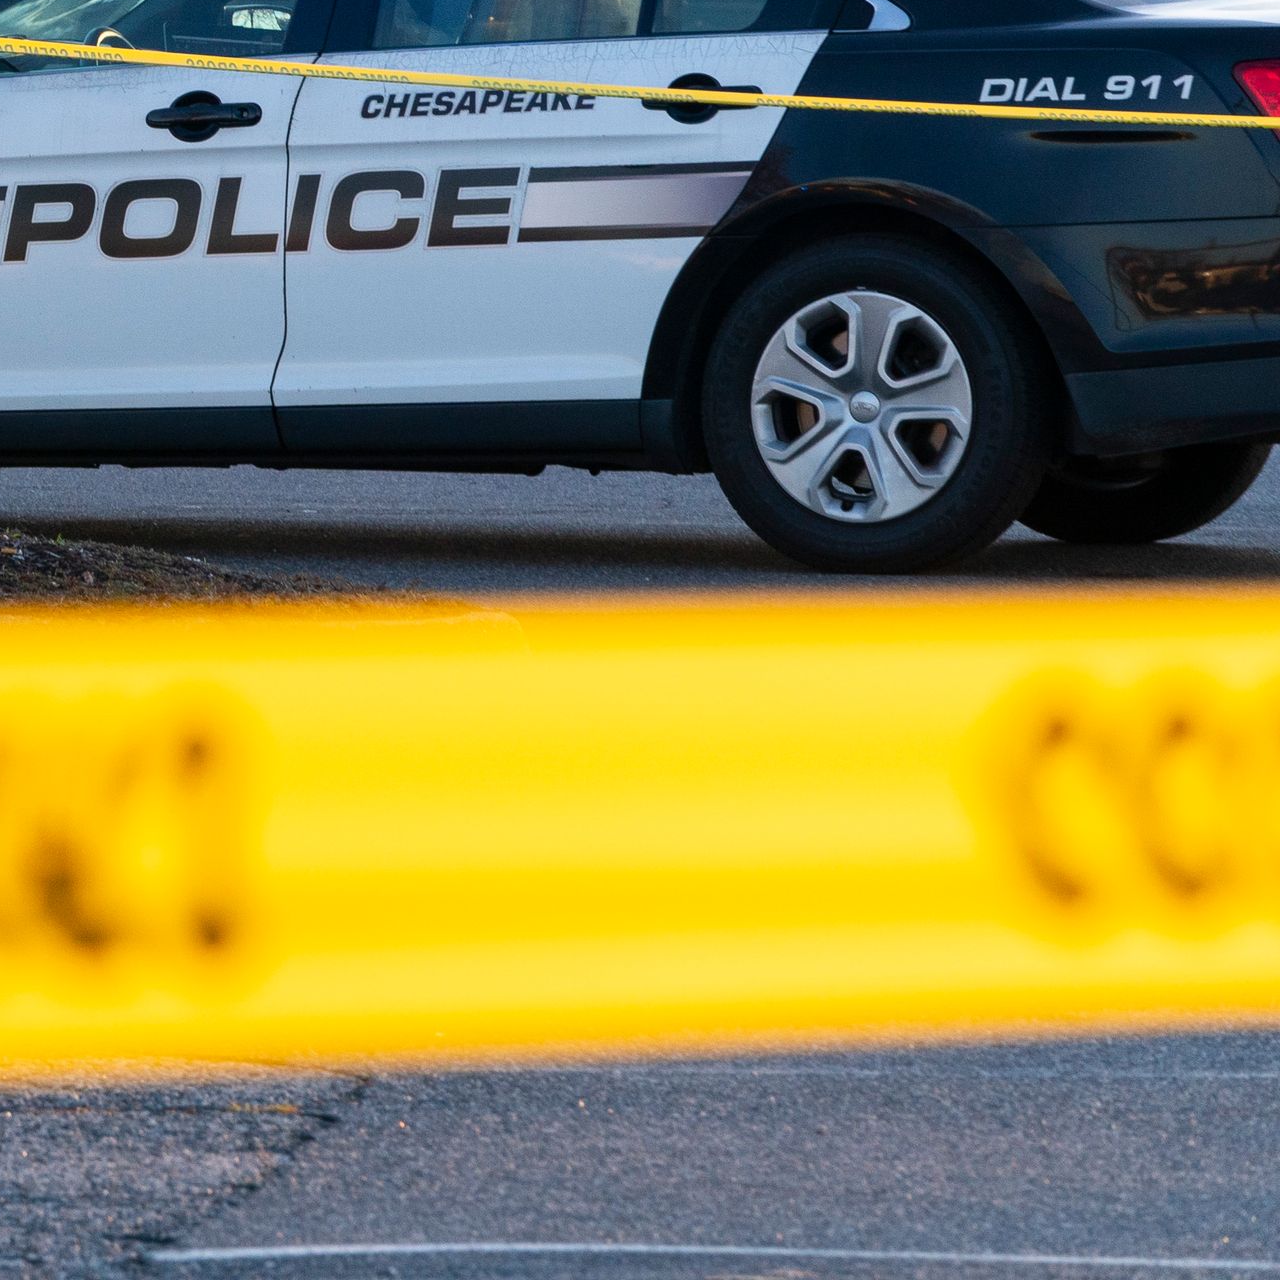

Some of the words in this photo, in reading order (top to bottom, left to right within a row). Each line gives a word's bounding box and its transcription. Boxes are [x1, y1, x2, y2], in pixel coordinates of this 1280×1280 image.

[979, 77, 1086, 102] DIAL
[1104, 74, 1194, 100] 911
[360, 90, 597, 120] CHESAPEAKE
[1, 166, 522, 263] POLICE
